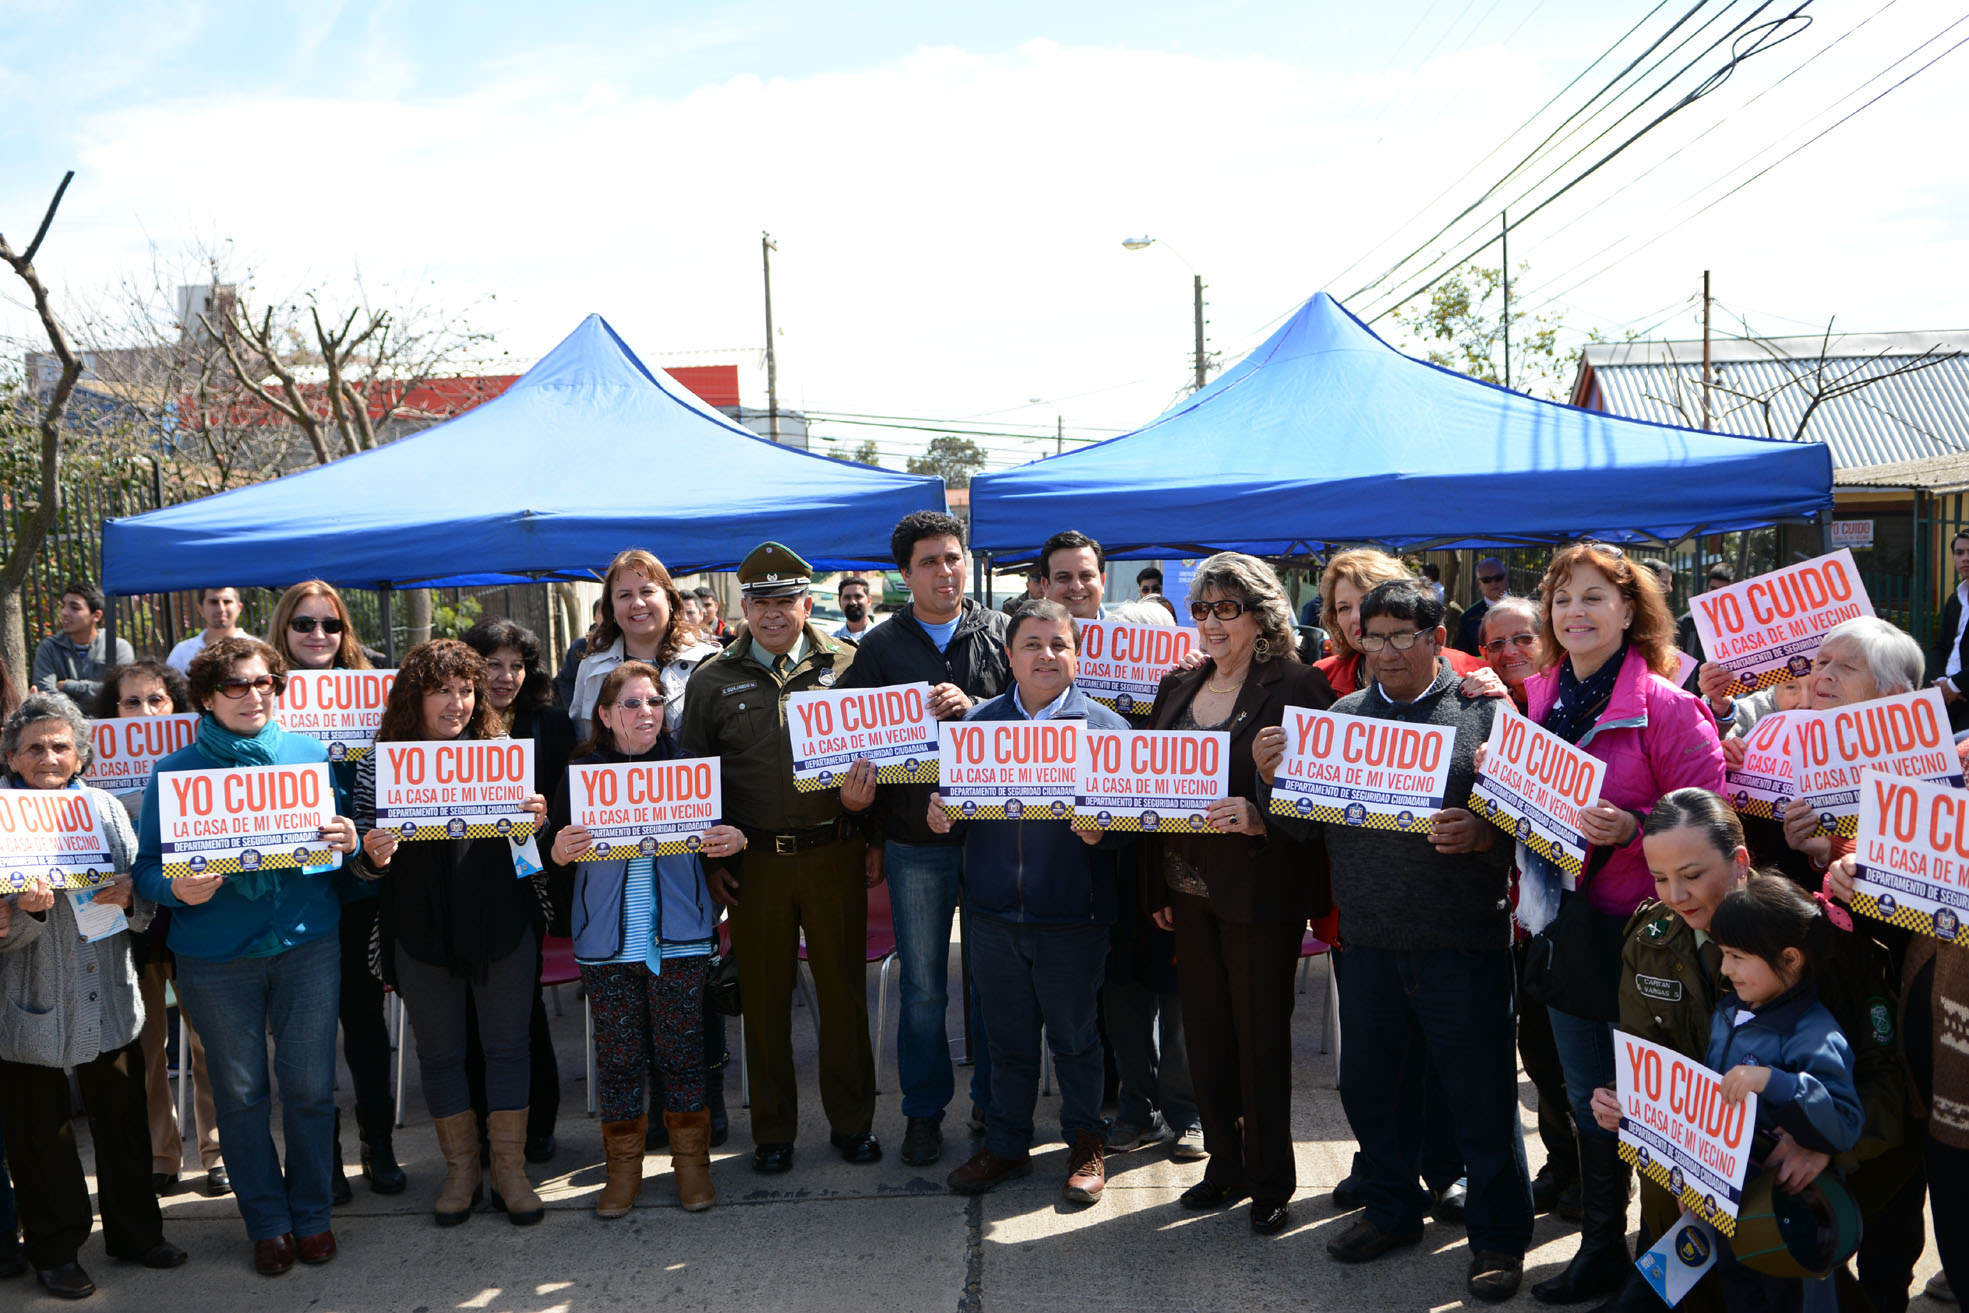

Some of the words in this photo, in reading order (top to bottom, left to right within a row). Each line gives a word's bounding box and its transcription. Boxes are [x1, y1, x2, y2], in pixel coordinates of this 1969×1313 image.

[1842, 522, 1870, 534] CUIDO
[1701, 593, 1744, 638] YO
[1747, 560, 1852, 625] CUIDO
[1112, 627, 1190, 664] CUIDO
[1714, 642, 1730, 659] LA
[1731, 632, 1767, 655] CASA
[1767, 626, 1788, 643] DE
[1789, 619, 1808, 638] MI
[1808, 603, 1862, 631] VECINO
[1774, 647, 1783, 657] DE
[1085, 662, 1111, 678] CASA
[1115, 665, 1128, 679] DE
[1132, 667, 1144, 680] MI
[1120, 683, 1151, 693] SEGURIDAD
[291, 714, 320, 728] CASA
[323, 714, 337, 727] DE
[341, 713, 355, 727] MI
[359, 713, 384, 726] VEC
[797, 701, 833, 737] YO
[840, 688, 924, 731] CUIDO
[803, 742, 816, 757] LA
[819, 737, 848, 754] CASA
[851, 734, 865, 748] DE
[869, 731, 882, 746] MI
[885, 726, 926, 744] VECINO
[950, 727, 984, 764] YO
[995, 726, 1076, 764] CUIDO
[1296, 714, 1334, 759] YO
[1343, 722, 1443, 772] CUIDO
[1746, 714, 1786, 751] YO
[1796, 718, 1828, 769] YO
[1835, 698, 1940, 762] CUIDO
[100, 761, 129, 776] CASA
[134, 760, 149, 775] DE
[388, 747, 425, 785] YO
[436, 744, 524, 784] CUIDO
[805, 755, 850, 769] DEPARTAMENTO
[859, 748, 893, 759] SEGURIDAD
[894, 743, 928, 755] CIUDADANA
[1087, 735, 1121, 773] YO
[1131, 735, 1219, 776] CUIDO
[1498, 713, 1526, 764] YO
[1526, 732, 1595, 807] CUIDO
[1747, 754, 1778, 776] CASA
[581, 769, 617, 806] YO
[627, 763, 711, 805] CUIDO
[950, 768, 963, 783] LA
[967, 768, 996, 783] CASA
[1000, 768, 1014, 782] DE
[1019, 768, 1032, 782] MI
[1036, 768, 1076, 783] VECINO
[1086, 778, 1099, 792] LA
[1103, 777, 1132, 794] CASA
[1136, 778, 1150, 794] DE
[1155, 780, 1168, 794] MI
[1174, 779, 1217, 796] VECINO
[1288, 759, 1302, 777] LA
[1307, 762, 1340, 782] CASA
[1346, 769, 1363, 785] DE
[1367, 770, 1383, 788] MI
[1388, 773, 1434, 793] VECINO
[1772, 782, 1781, 791] DE
[1800, 774, 1812, 792] LA
[1814, 768, 1849, 790] CASA
[1892, 752, 1948, 776] VECINO
[172, 776, 213, 816] YO
[224, 769, 319, 814] CUIDO
[388, 789, 402, 804] LA
[406, 788, 438, 804] CASA
[442, 787, 457, 802] DE
[462, 787, 476, 802] MI
[481, 785, 524, 801] VECINO
[950, 787, 996, 796] DEPARTAMENTO
[998, 787, 1006, 796] DE
[1007, 787, 1041, 796] SEGURIDAD
[1086, 797, 1132, 807] DEPARTAMENTO
[1134, 798, 1143, 807] DE
[1144, 798, 1178, 808] SEGURIDAD
[1180, 800, 1215, 809] CIUDADAN
[1285, 779, 1339, 797] DEPARTAMENTO
[1340, 787, 1350, 798] DE
[1351, 788, 1390, 804] SEGURIDAD
[1391, 794, 1430, 807] CIUDADANA
[1488, 757, 1500, 776] LA
[1500, 765, 1521, 789] CASA
[1524, 779, 1536, 800] DE
[1536, 788, 1548, 808] MI
[1550, 794, 1583, 829] VECINO
[0, 796, 15, 832] O
[18, 796, 94, 832] CUIDO
[174, 822, 189, 838] LA
[194, 818, 228, 836] CASA
[233, 817, 252, 833] DE
[254, 815, 270, 832] MI
[272, 812, 321, 830] VECINO
[388, 807, 438, 818] DEPARTAMENTO
[450, 805, 486, 816] SEGURIDAD
[487, 804, 523, 814] CIUDADAN
[582, 811, 596, 826] LA
[600, 808, 630, 824] CASA
[634, 807, 648, 822] DE
[653, 806, 666, 821] MI
[670, 802, 712, 819] VECINO
[1875, 780, 1918, 842] YO
[63, 835, 100, 850] VECINO
[174, 839, 230, 852] DEPARTAMENTO
[231, 838, 241, 847] DE
[242, 834, 281, 847] SEGURIDAD
[588, 828, 631, 838] EPARTAMENTO
[632, 826, 641, 835] DE
[642, 825, 676, 835] SEGURIDAD
[678, 821, 712, 832] CIUDADANA
[1869, 840, 1884, 864] LA
[1890, 846, 1927, 877] CASA
[1933, 856, 1953, 883] DE
[1866, 868, 1926, 897] DEPARTAMENTO
[1927, 886, 1940, 899] DE
[1626, 1042, 1662, 1102] YO
[1670, 1060, 1746, 1149] CUIDO
[1629, 1096, 1641, 1118] LA
[1644, 1104, 1669, 1136] CASA
[1671, 1118, 1684, 1144] DE
[1685, 1130, 1697, 1154] MI
[1699, 1137, 1736, 1179] VECINO
